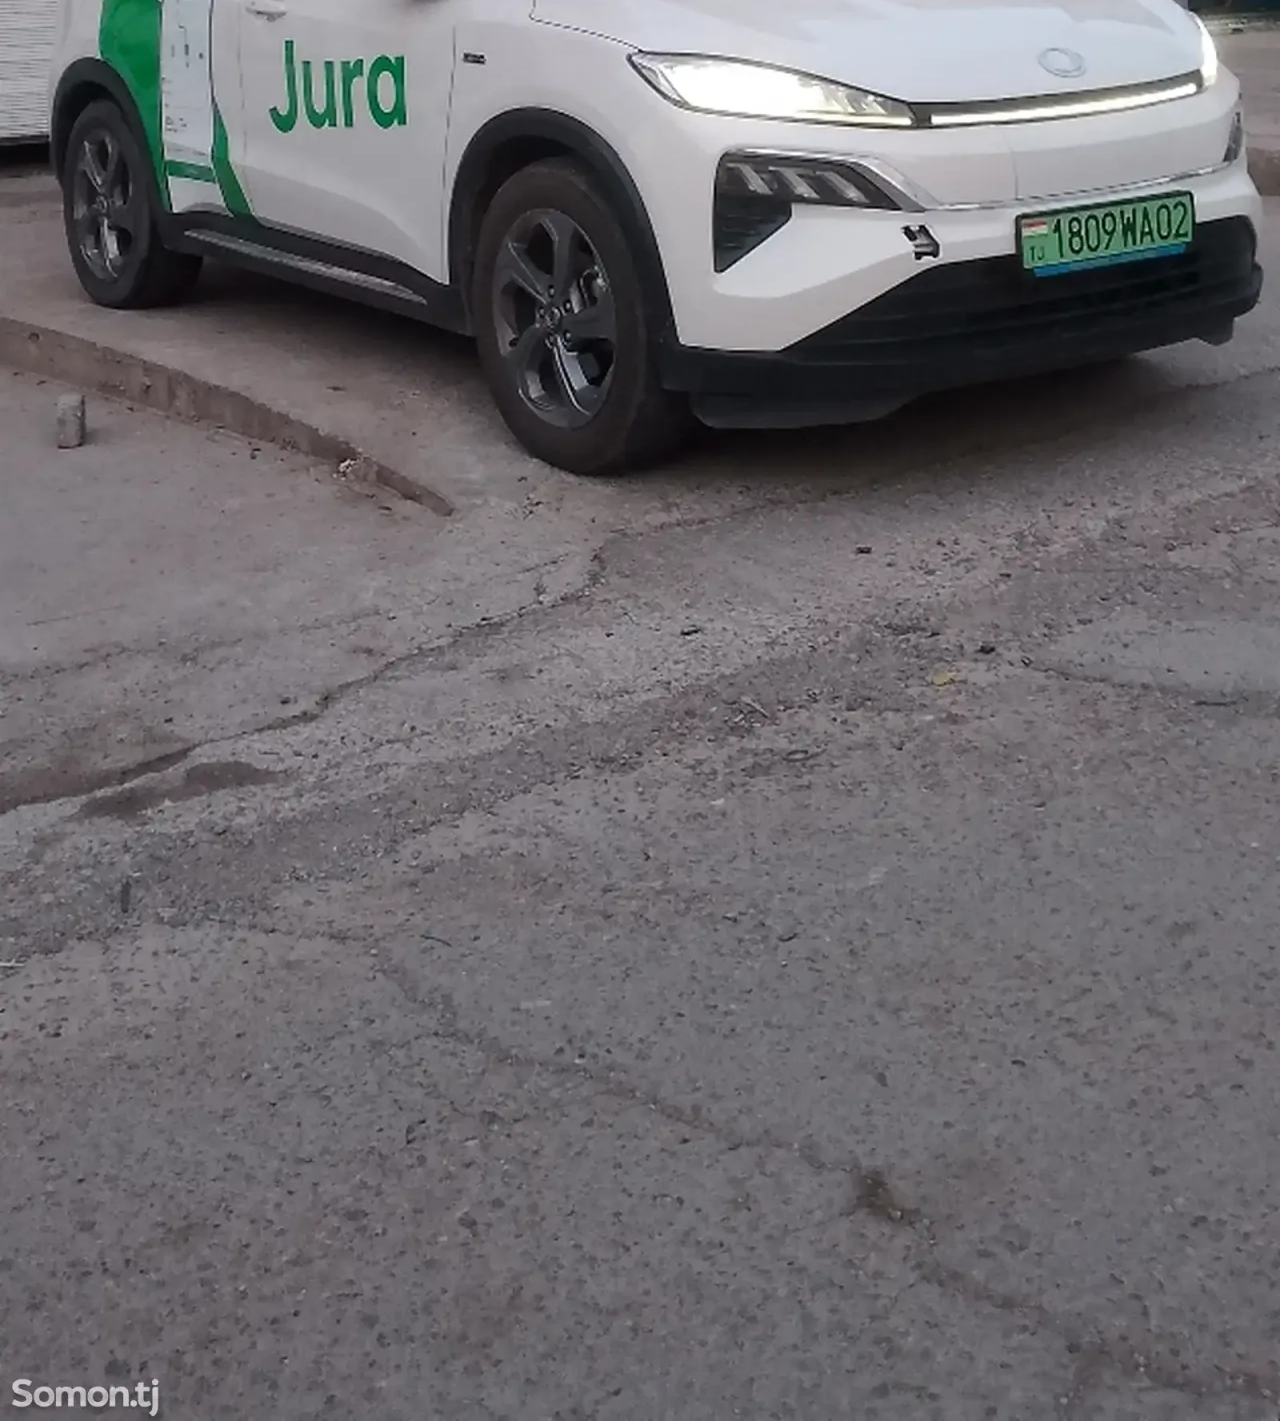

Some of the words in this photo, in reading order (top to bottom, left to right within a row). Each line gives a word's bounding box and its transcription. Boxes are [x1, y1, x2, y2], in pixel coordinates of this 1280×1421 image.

[269, 40, 407, 133] Jura
[1029, 244, 1045, 262] TJ
[1053, 200, 1188, 258] 1809WA02
